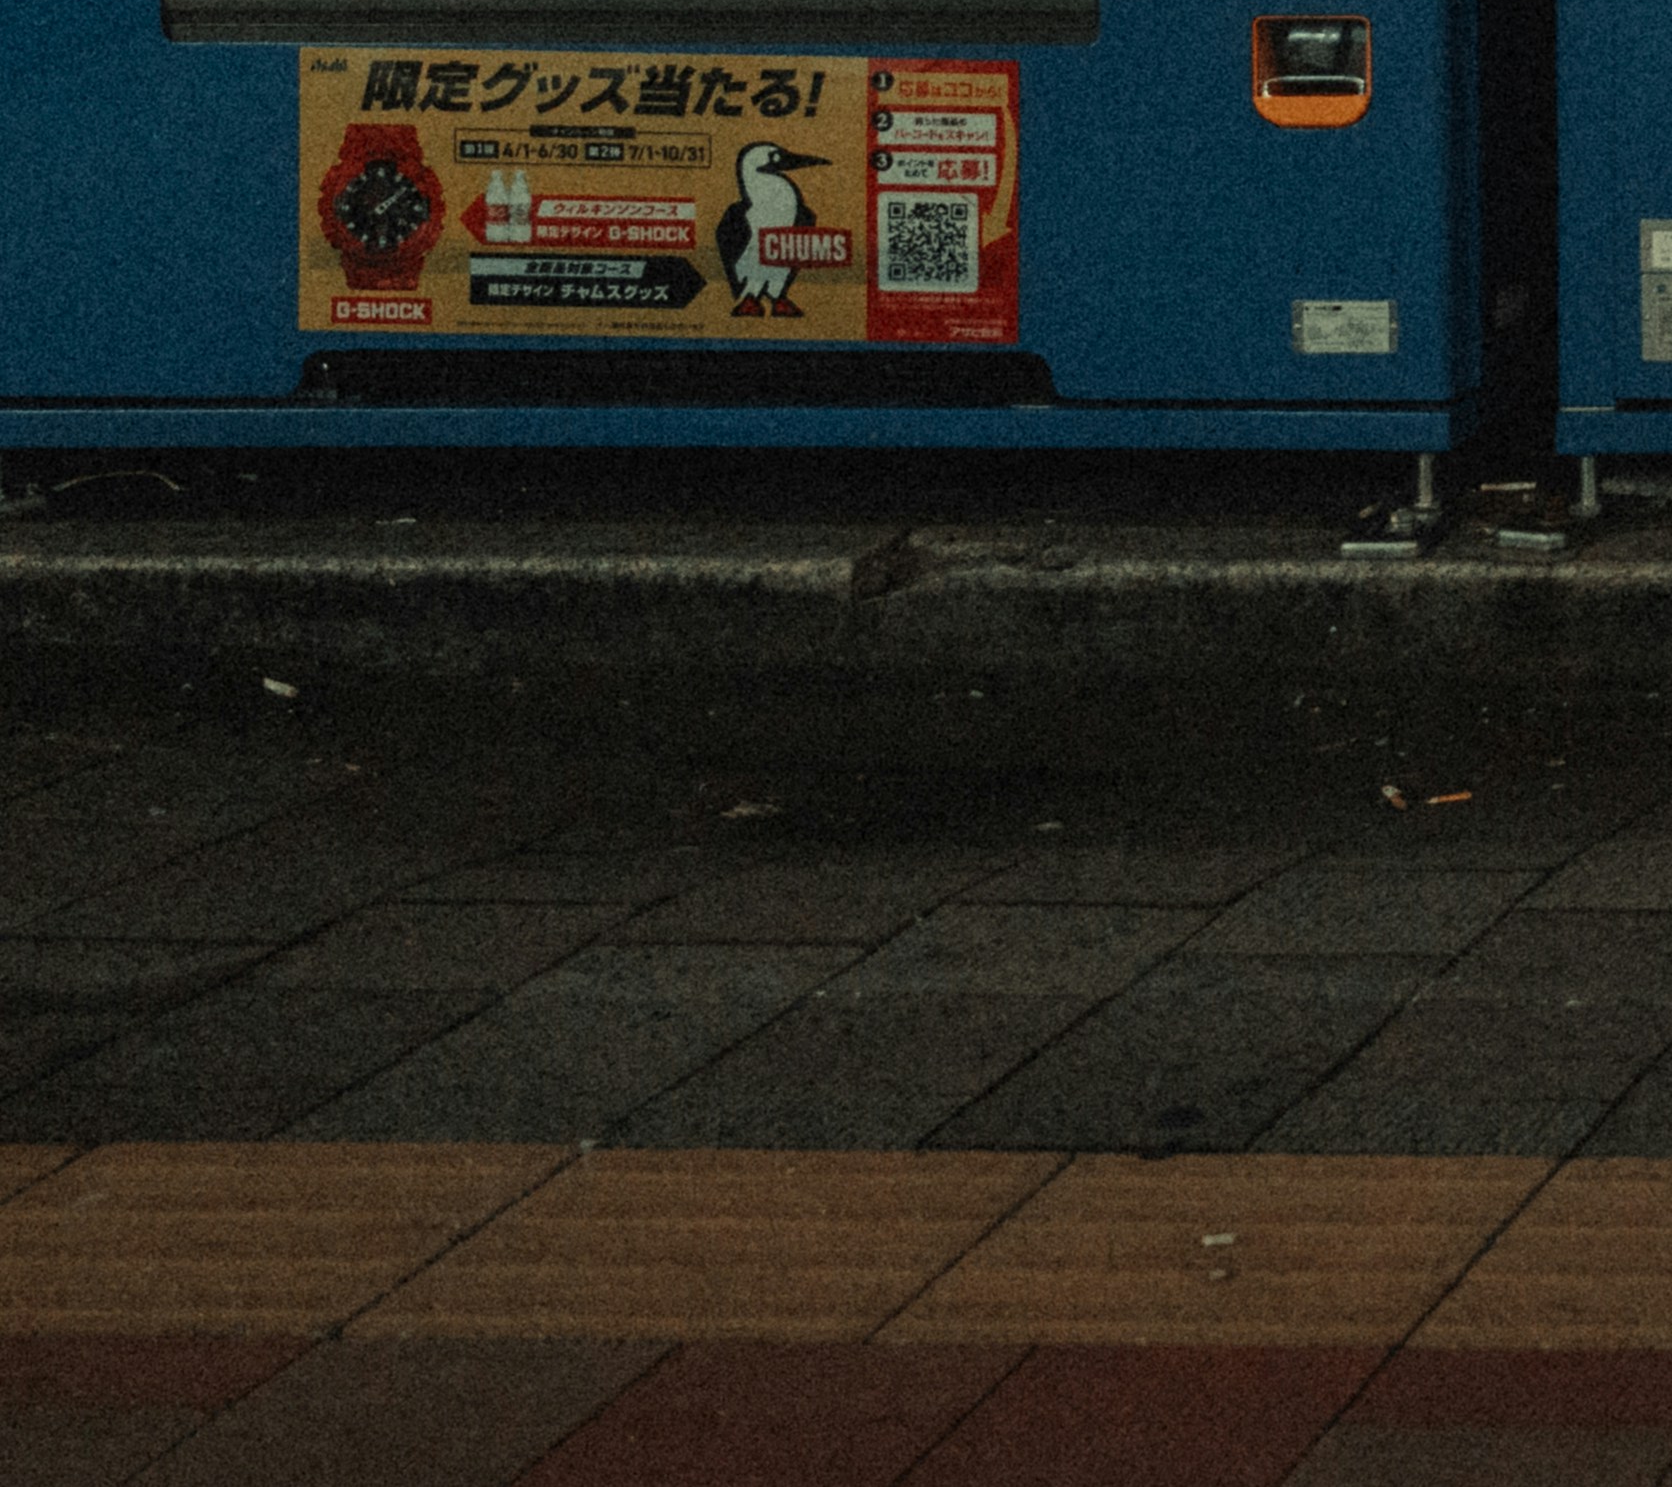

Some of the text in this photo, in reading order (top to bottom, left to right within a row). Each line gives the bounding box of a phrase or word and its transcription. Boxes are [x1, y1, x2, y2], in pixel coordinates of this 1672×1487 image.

[361, 61, 823, 119] 限定グッズ当たる!
[502, 141, 578, 160] 4/1-6/30
[628, 144, 706, 163] 7/1-10/31
[608, 224, 690, 244] G-SHOCK
[764, 231, 846, 265] CHUMS
[335, 301, 427, 323] G-SHOCK
